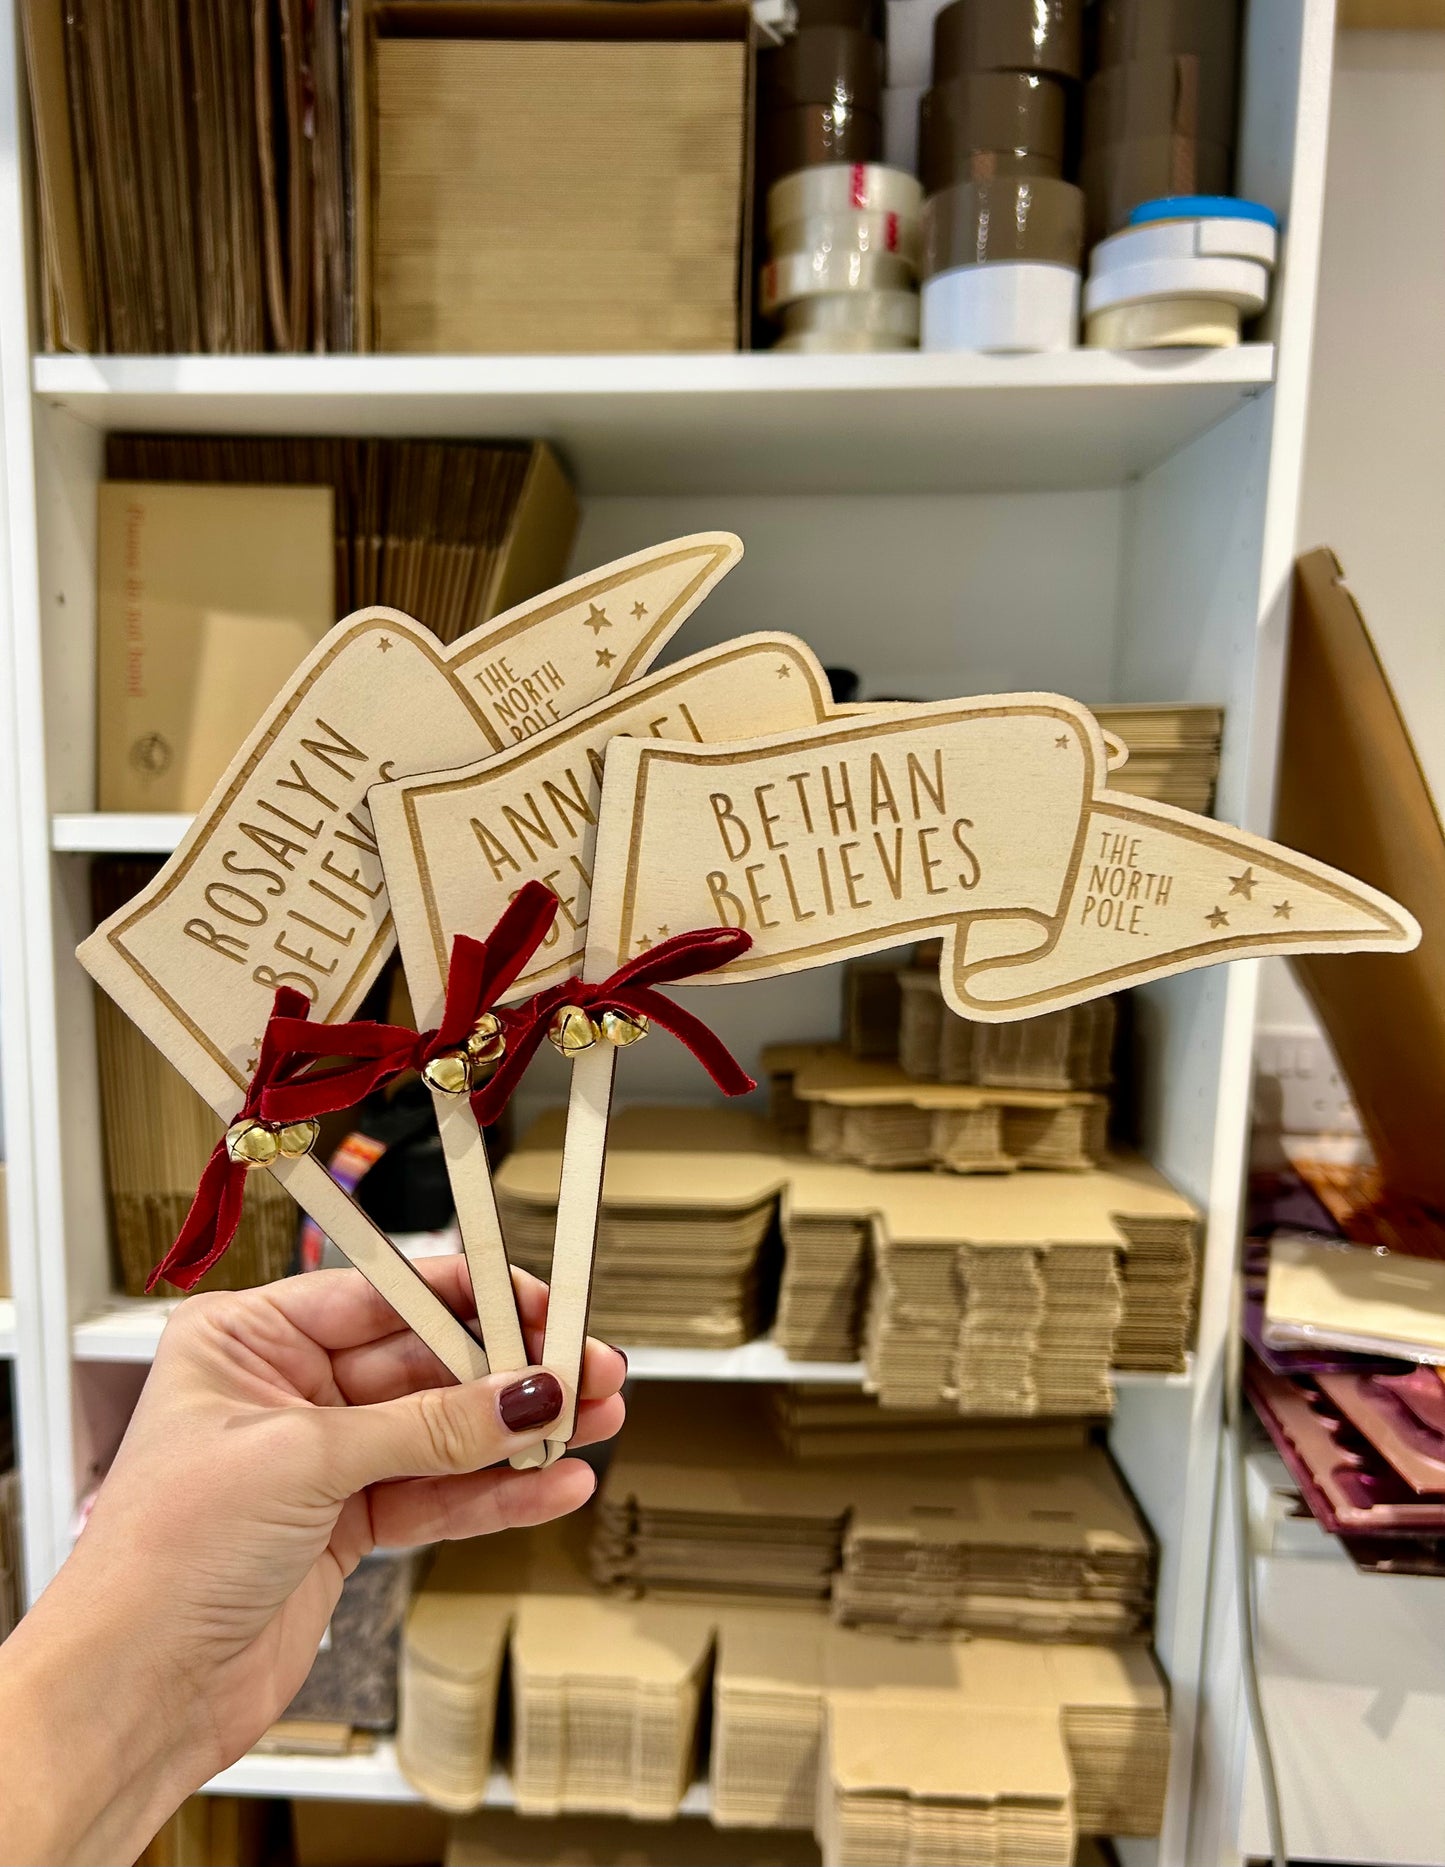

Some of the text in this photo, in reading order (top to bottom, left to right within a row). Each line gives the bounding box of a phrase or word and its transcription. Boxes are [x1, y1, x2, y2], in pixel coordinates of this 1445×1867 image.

[473, 656, 521, 697] THE
[492, 660, 566, 727] NORTH
[708, 748, 947, 863] BETHAN
[182, 717, 370, 966] ROSALYN
[705, 817, 981, 930] BELIEVES
[1100, 831, 1142, 869] THE
[1087, 864, 1174, 907] NORTH
